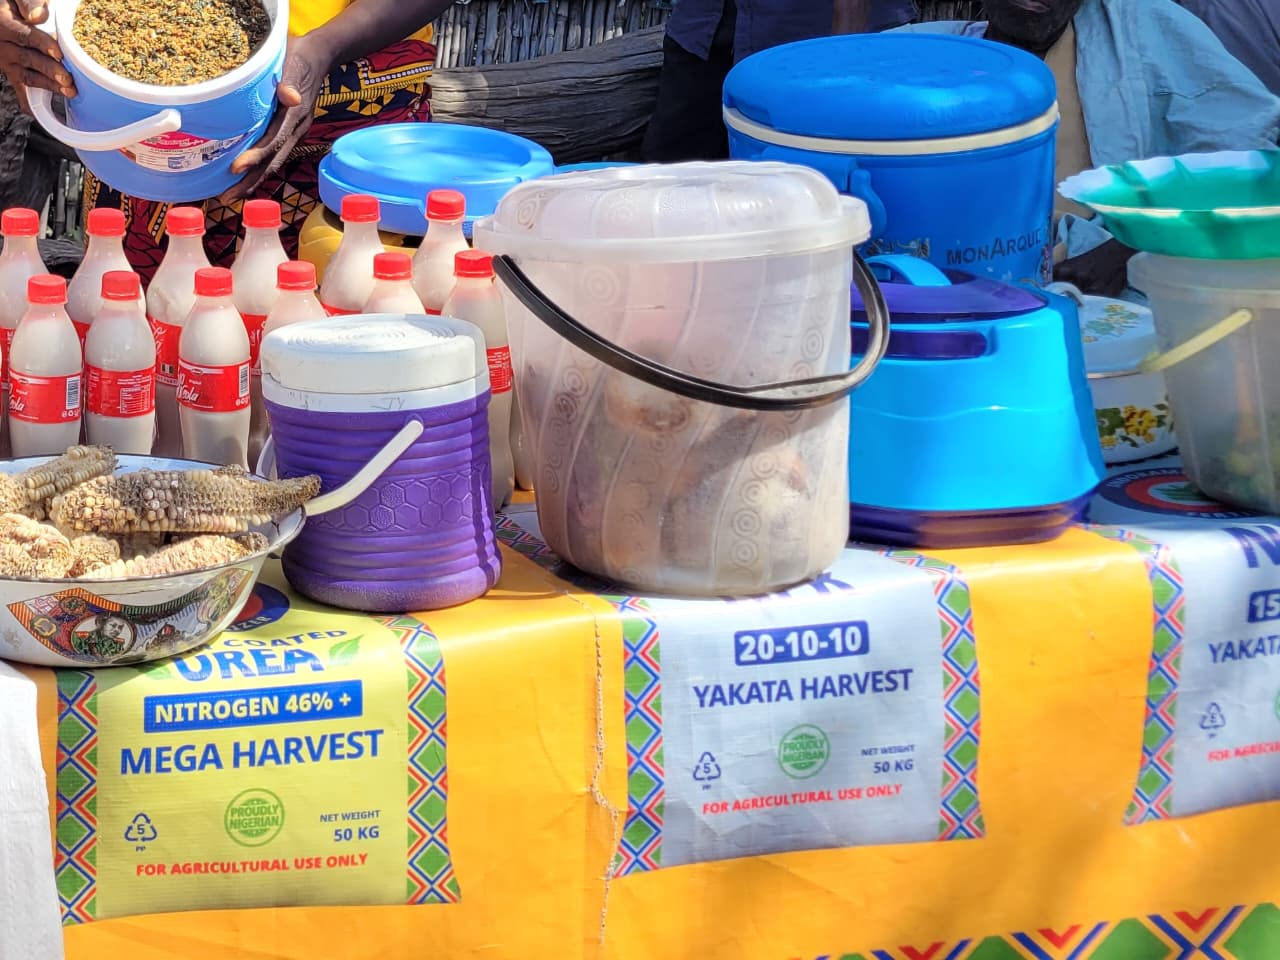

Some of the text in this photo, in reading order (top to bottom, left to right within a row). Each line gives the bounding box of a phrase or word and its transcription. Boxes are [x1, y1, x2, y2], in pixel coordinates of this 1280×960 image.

[223, 630, 347, 648] COATED
[738, 626, 862, 662] 20-10-10
[173, 647, 325, 682] UREA
[692, 668, 914, 708] YAKATA HARVEST
[155, 696, 279, 724] NITROGEN
[285, 692, 333, 713] 46%
[121, 729, 384, 775] MEGA HARVEST
[873, 759, 914, 773] 50 KG
[702, 784, 903, 815] FOR AGRICULTURAL USE ONLY
[230, 804, 279, 818] PROUDLY
[320, 810, 381, 823] NET WEIGHT
[136, 824, 145, 835] 5
[229, 815, 280, 829] NIGERIAN
[333, 825, 379, 842] 50 KG
[136, 853, 368, 876] FOR AGRICULTURAL USE ONLY
